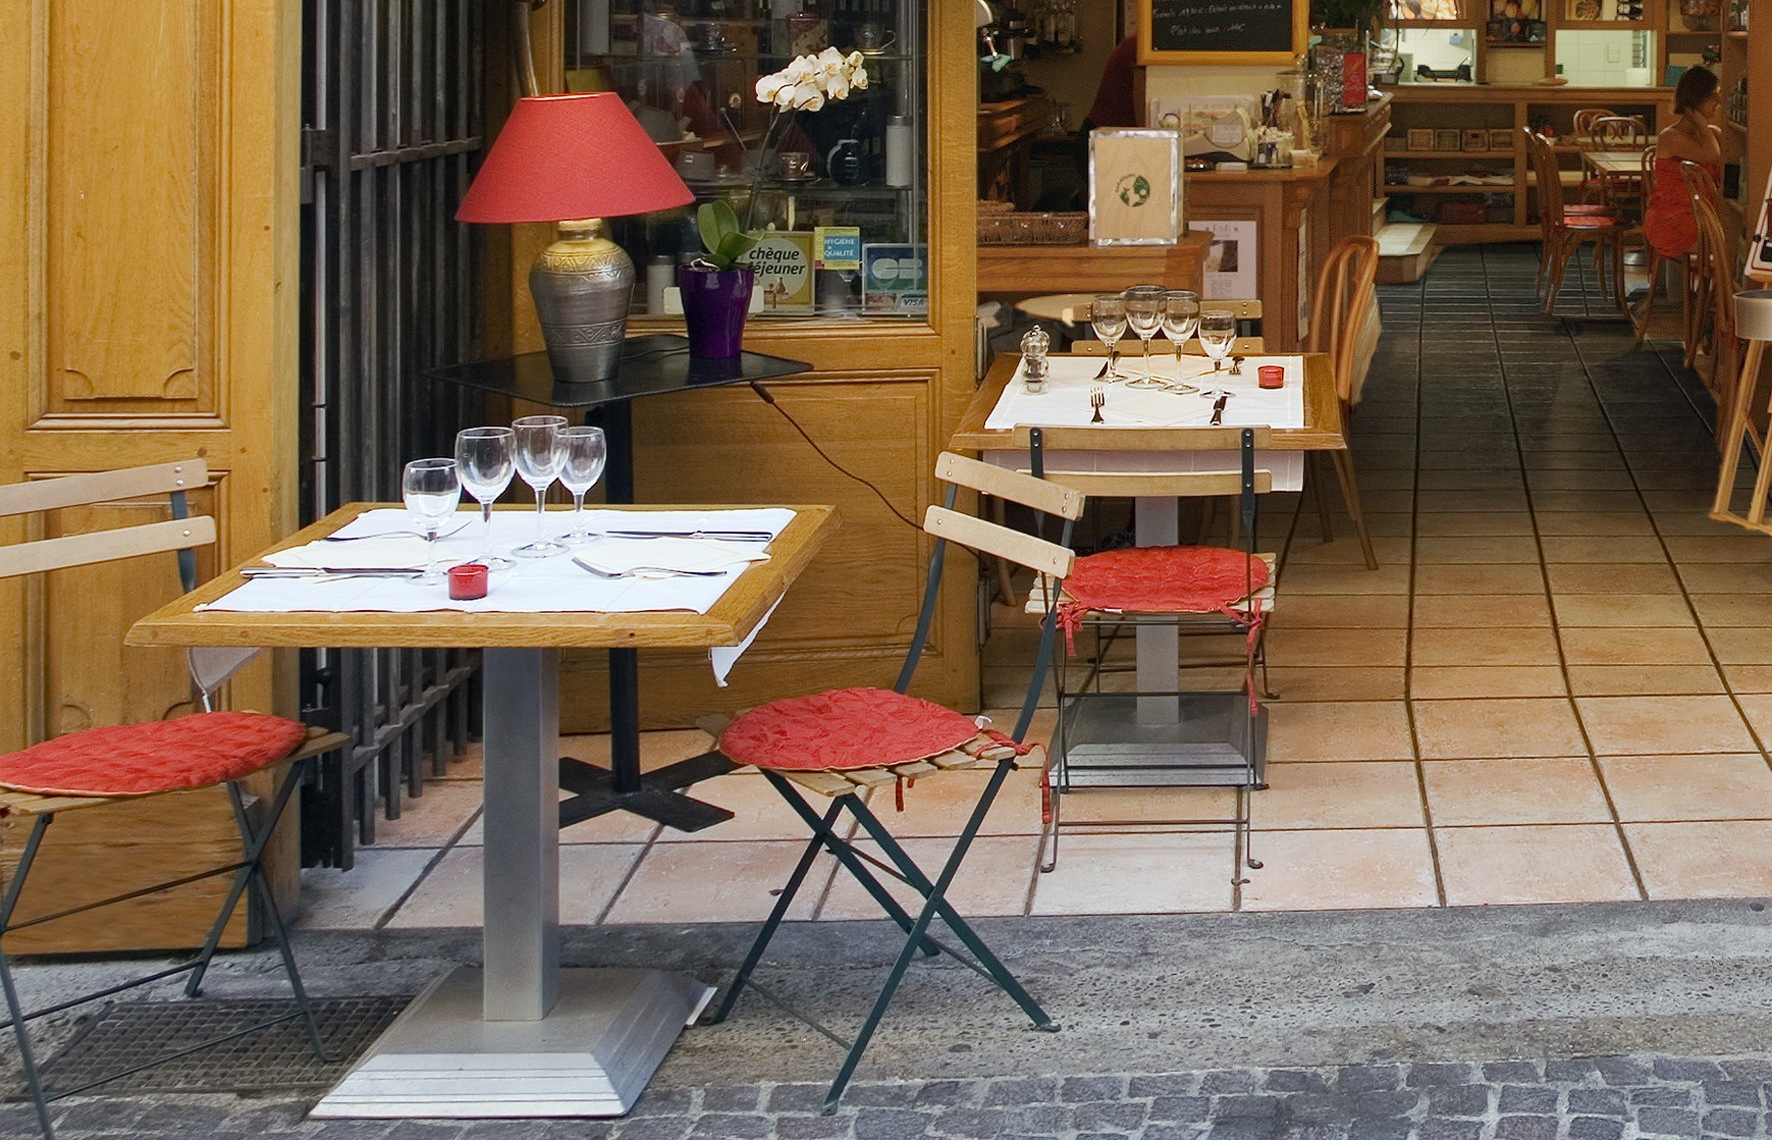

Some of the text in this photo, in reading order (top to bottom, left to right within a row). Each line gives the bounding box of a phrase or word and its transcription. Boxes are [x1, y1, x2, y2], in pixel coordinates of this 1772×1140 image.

[749, 246, 799, 263] chèque
[751, 262, 806, 278] éjeuner
[903, 298, 924, 306] VISA
